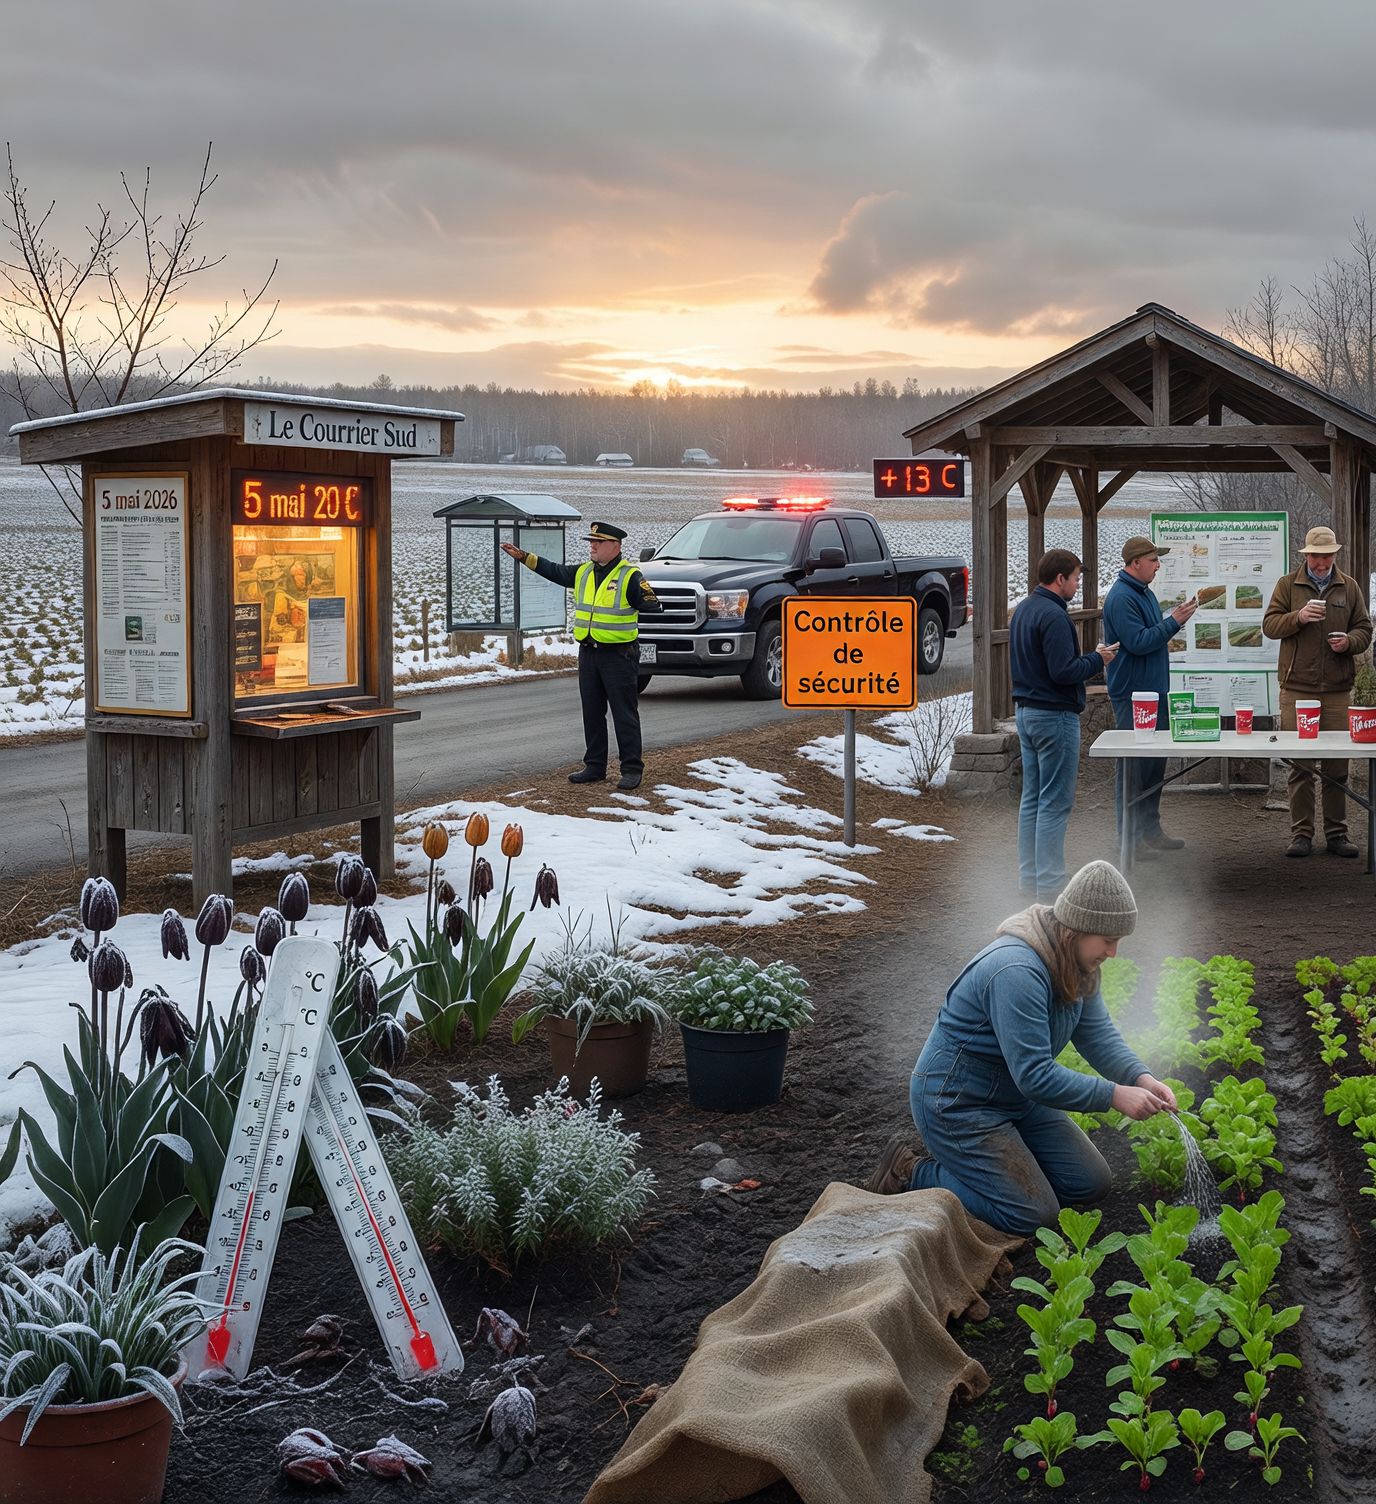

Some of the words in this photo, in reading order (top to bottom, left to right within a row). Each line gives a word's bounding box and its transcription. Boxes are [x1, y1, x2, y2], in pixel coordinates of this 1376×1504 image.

[268, 410, 294, 439] Le
[300, 413, 379, 446] Courrier
[384, 421, 417, 448] Sud
[102, 490, 111, 510] 5
[115, 489, 140, 510] mai
[144, 489, 178, 510] 2026
[244, 480, 262, 519] 5
[270, 483, 305, 518] mai
[794, 609, 904, 633] Contrôle
[833, 642, 864, 664] de
[798, 670, 900, 694] sécurité
[305, 971, 325, 992] °C
[300, 1008, 318, 1026] °C
